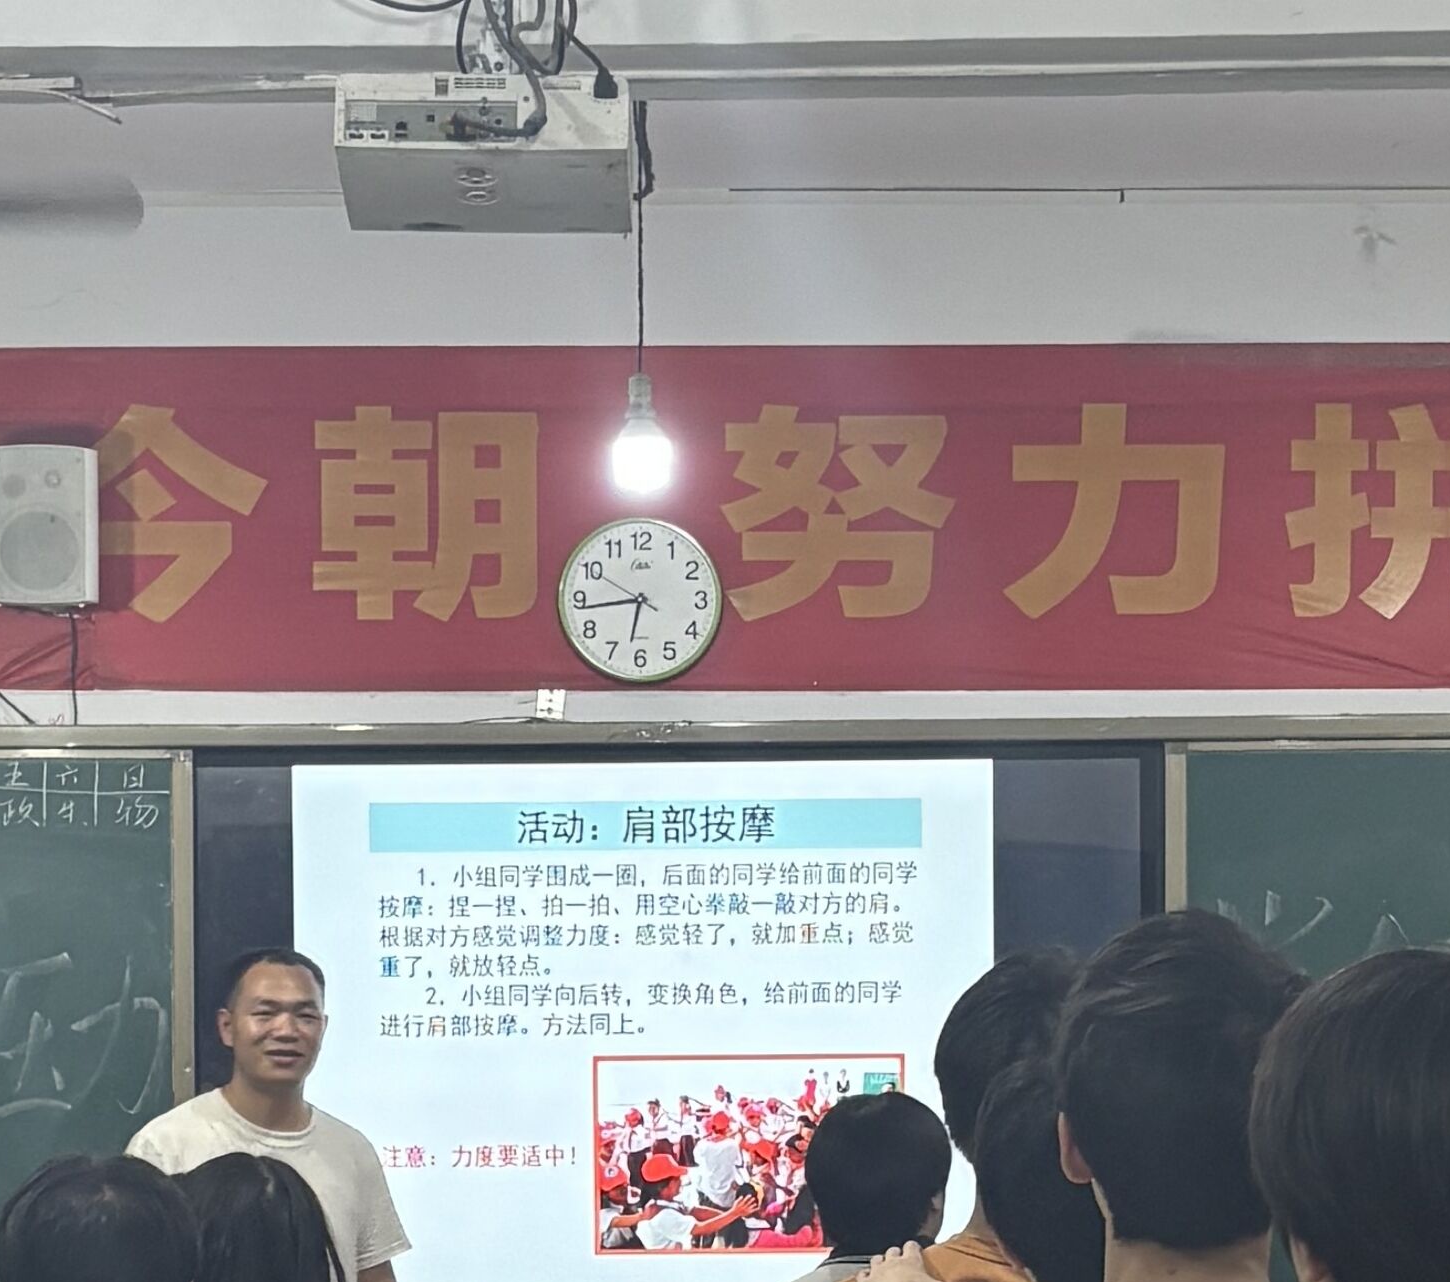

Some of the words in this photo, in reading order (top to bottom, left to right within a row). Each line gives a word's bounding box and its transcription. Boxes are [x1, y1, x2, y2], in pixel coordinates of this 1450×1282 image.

[604, 539, 622, 558] 11
[630, 531, 653, 551] 12
[667, 541, 675, 560] 1
[582, 561, 603, 580] 10
[685, 561, 699, 580] 2
[572, 590, 587, 609] 9
[694, 591, 708, 610] 3
[582, 620, 597, 639] 8
[685, 620, 698, 640] 4
[605, 641, 619, 660] 7
[633, 649, 647, 667] 6
[662, 641, 677, 660] 5
[3, 762, 31, 786] 五
[56, 763, 79, 786] 六
[115, 794, 159, 829] 物
[517, 805, 776, 845] 活动：肩部按摩
[378, 891, 903, 919] 按摩：捏一捏、拍一拍、用空心拳敲一敲对方的肩。
[378, 921, 914, 949] 根据对方感觉调整力度：感觉轻了，就加重点；感觉
[379, 953, 553, 979] 重了，就放轻点。
[380, 1012, 647, 1038] 进行肩部按摩。方法同上。
[382, 1145, 577, 1169] 注意：力度要适中！
